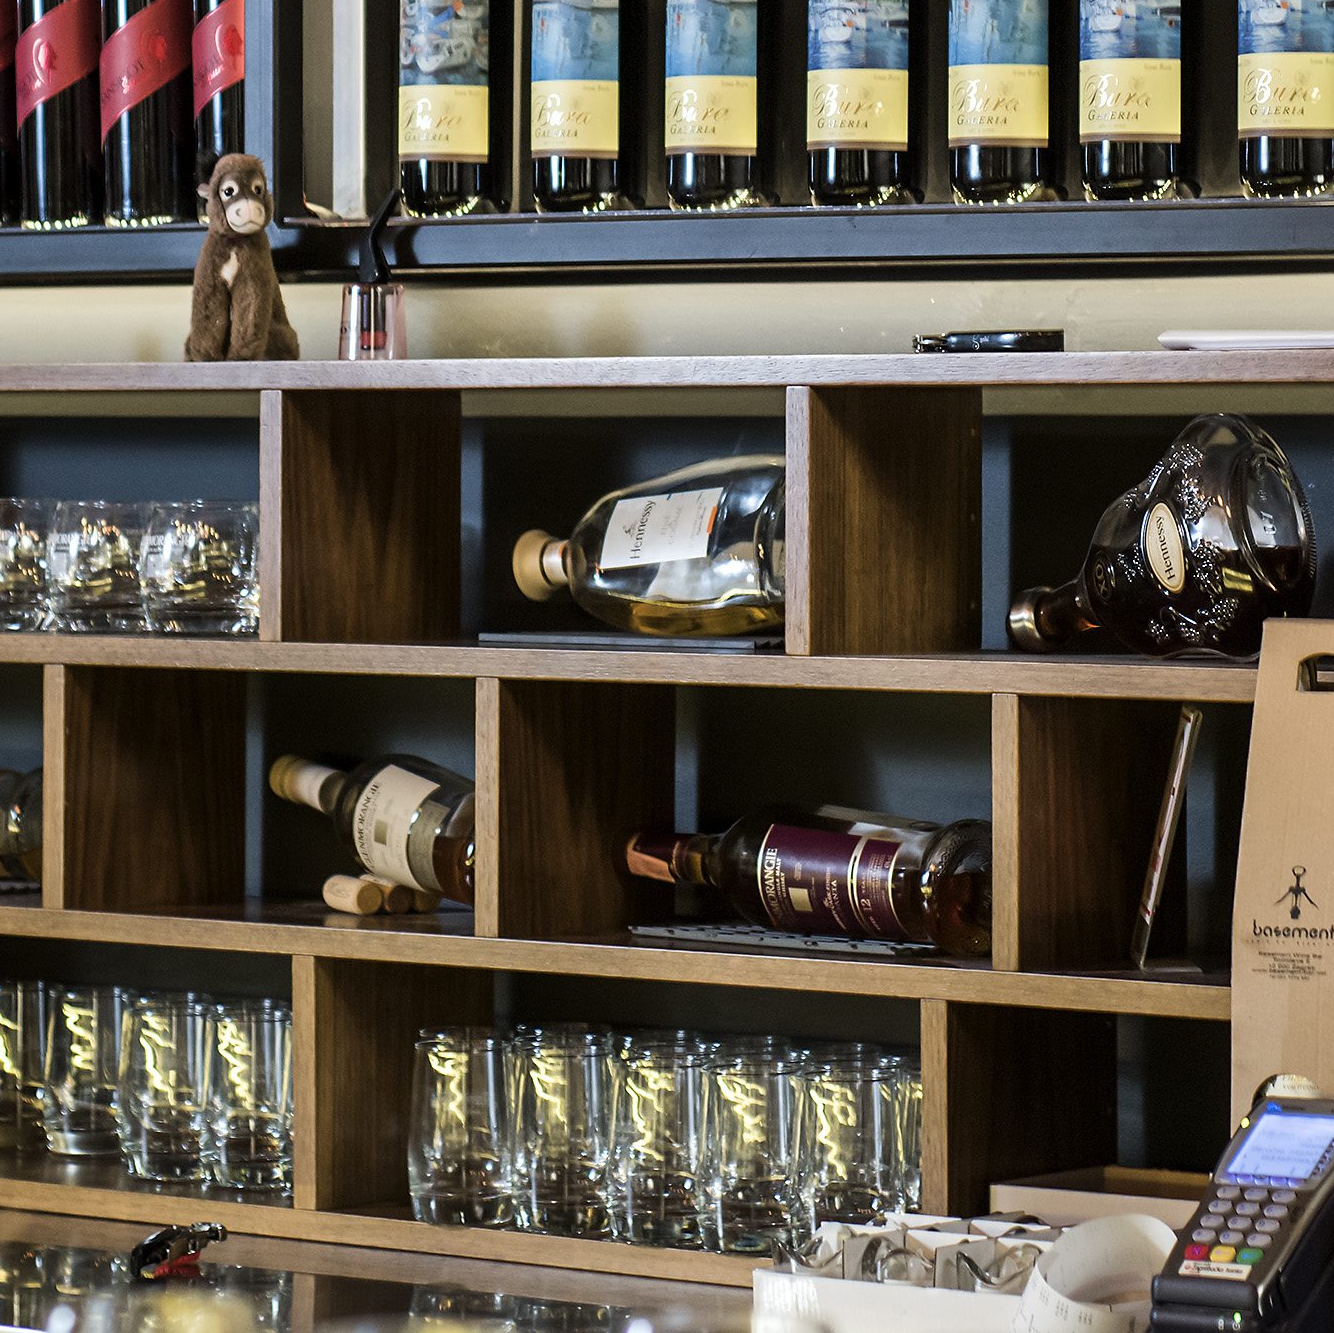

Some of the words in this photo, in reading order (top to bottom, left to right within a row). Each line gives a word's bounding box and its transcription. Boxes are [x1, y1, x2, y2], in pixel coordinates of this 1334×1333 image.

[629, 500, 657, 560] Hennessy
[1156, 515, 1176, 581] Hennessy
[1252, 918, 1334, 940] basement
